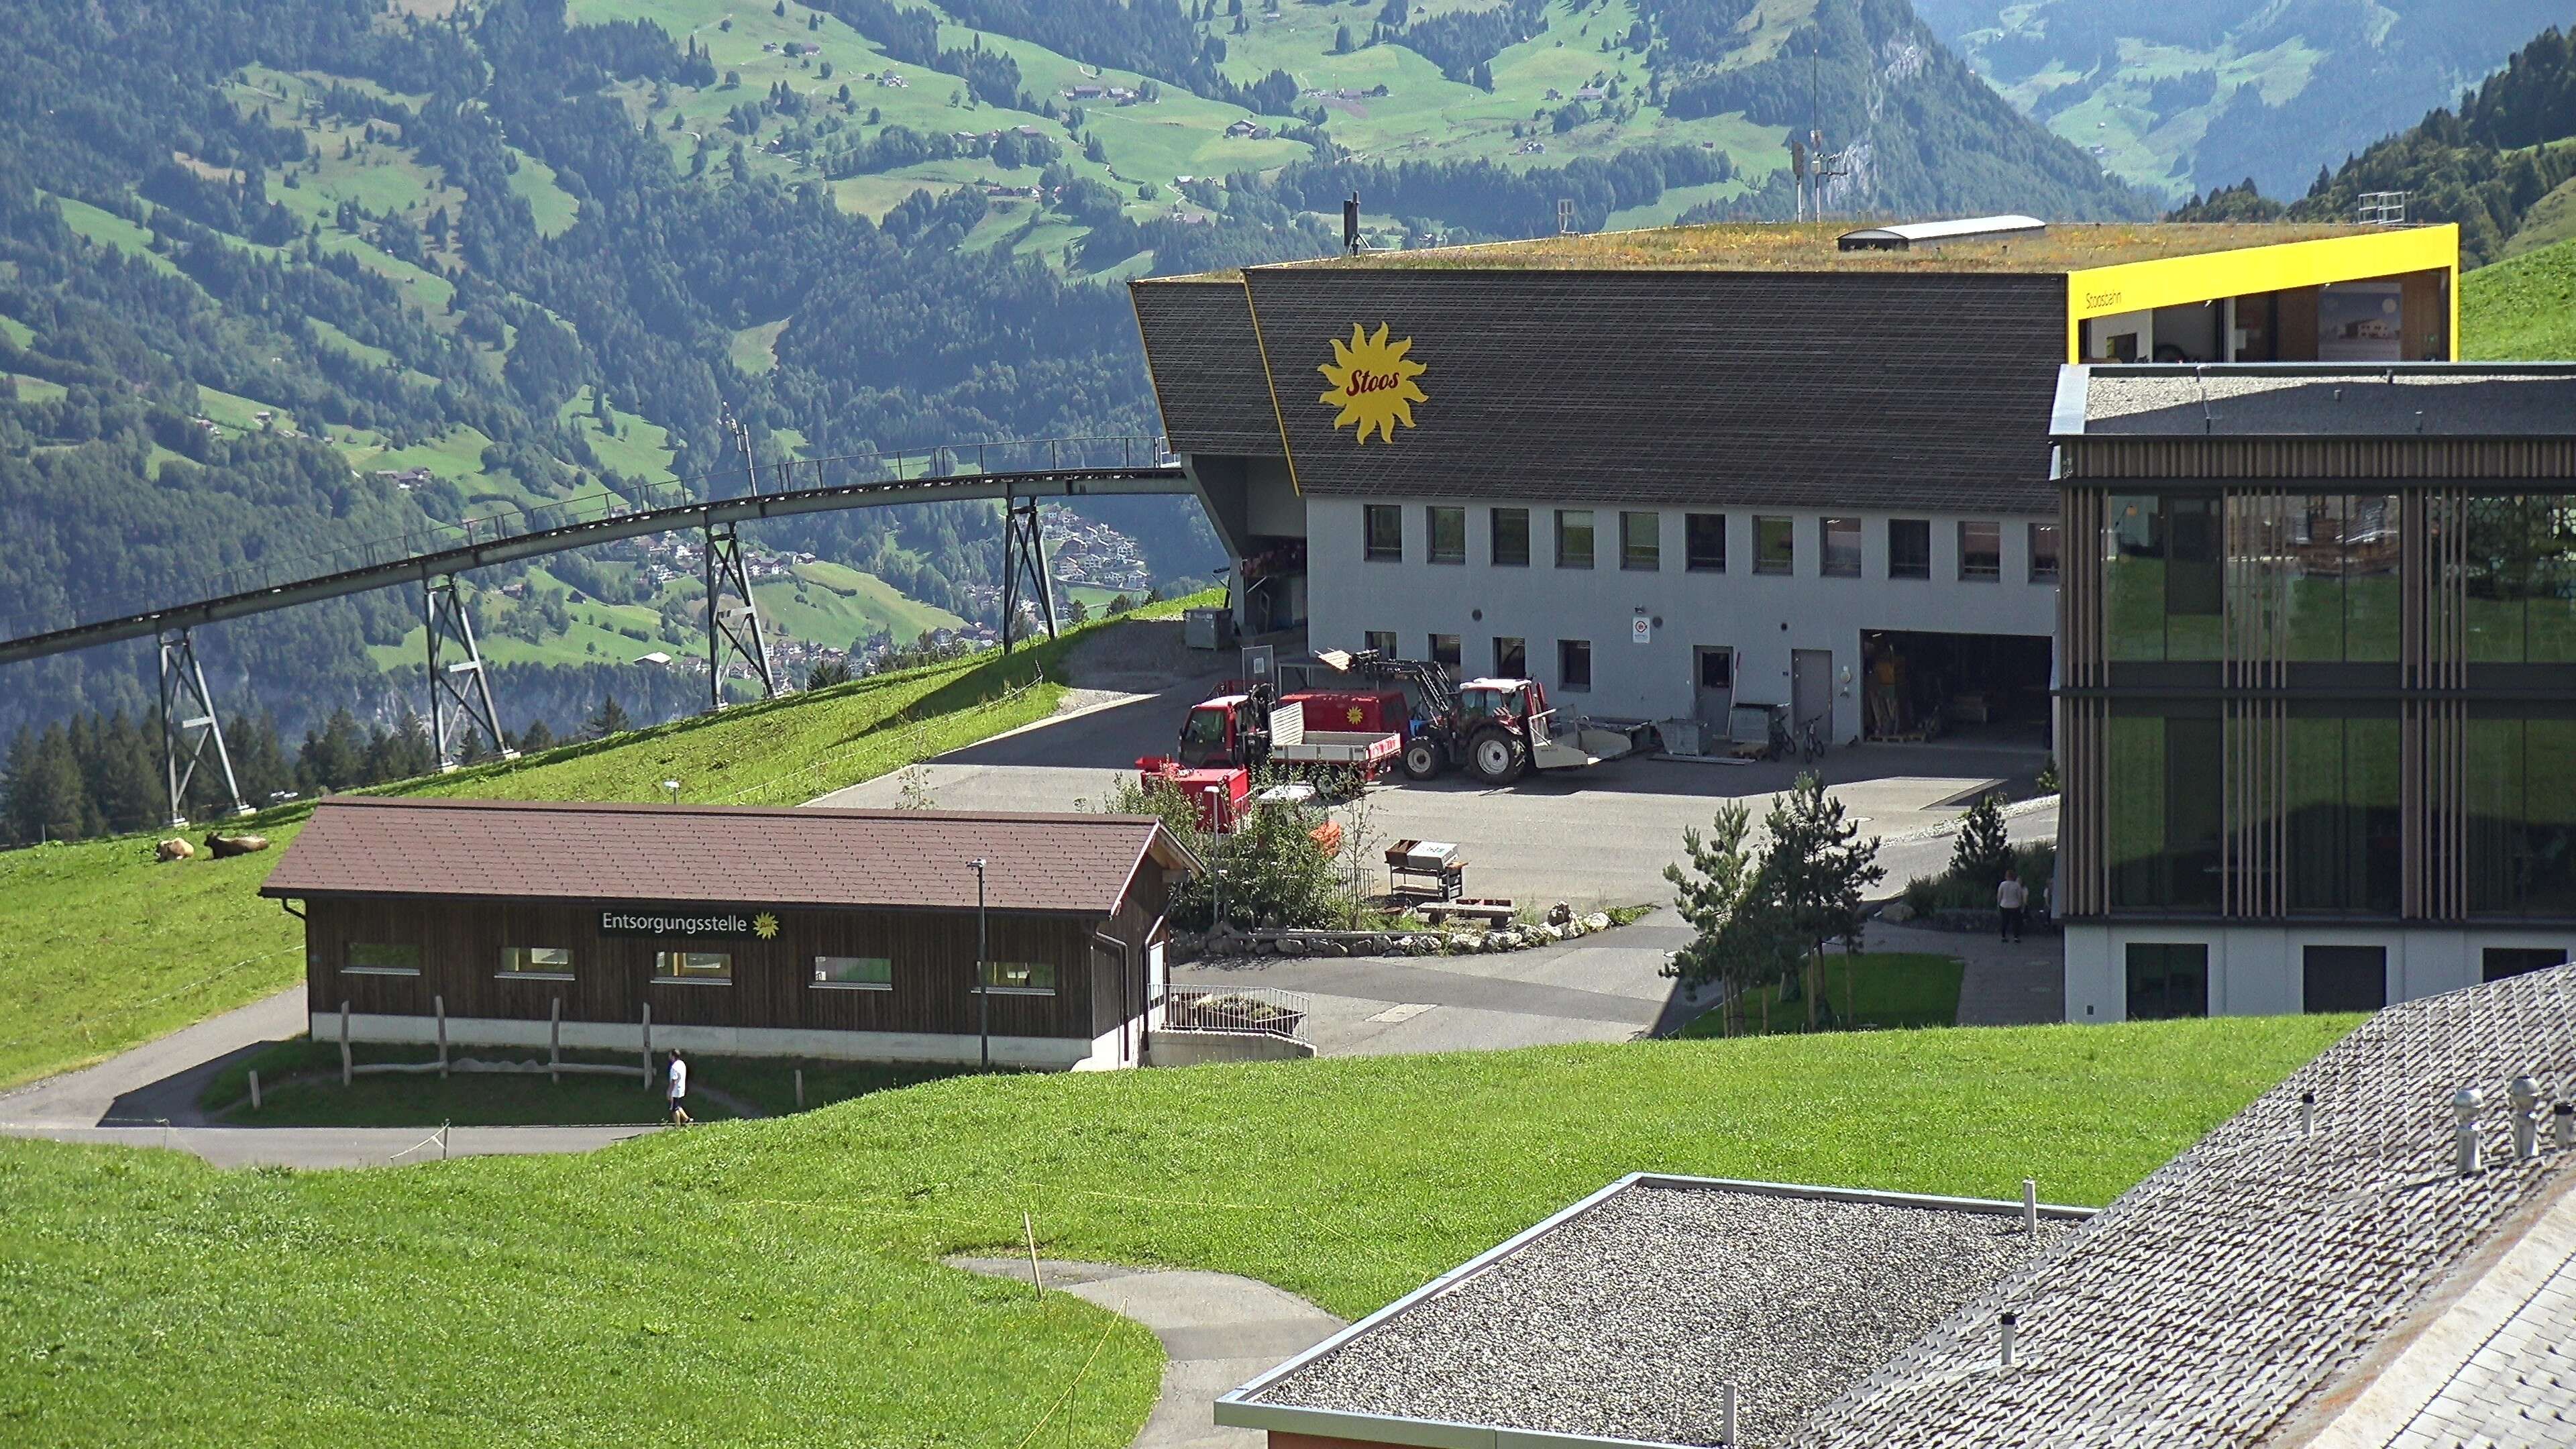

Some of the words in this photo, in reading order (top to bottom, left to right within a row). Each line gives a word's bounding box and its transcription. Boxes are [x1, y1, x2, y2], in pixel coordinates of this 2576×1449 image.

[2086, 289, 2121, 309] Stoosbahn
[1346, 370, 1399, 397] Stoos
[602, 912, 747, 934] Entsorgungsstelle
